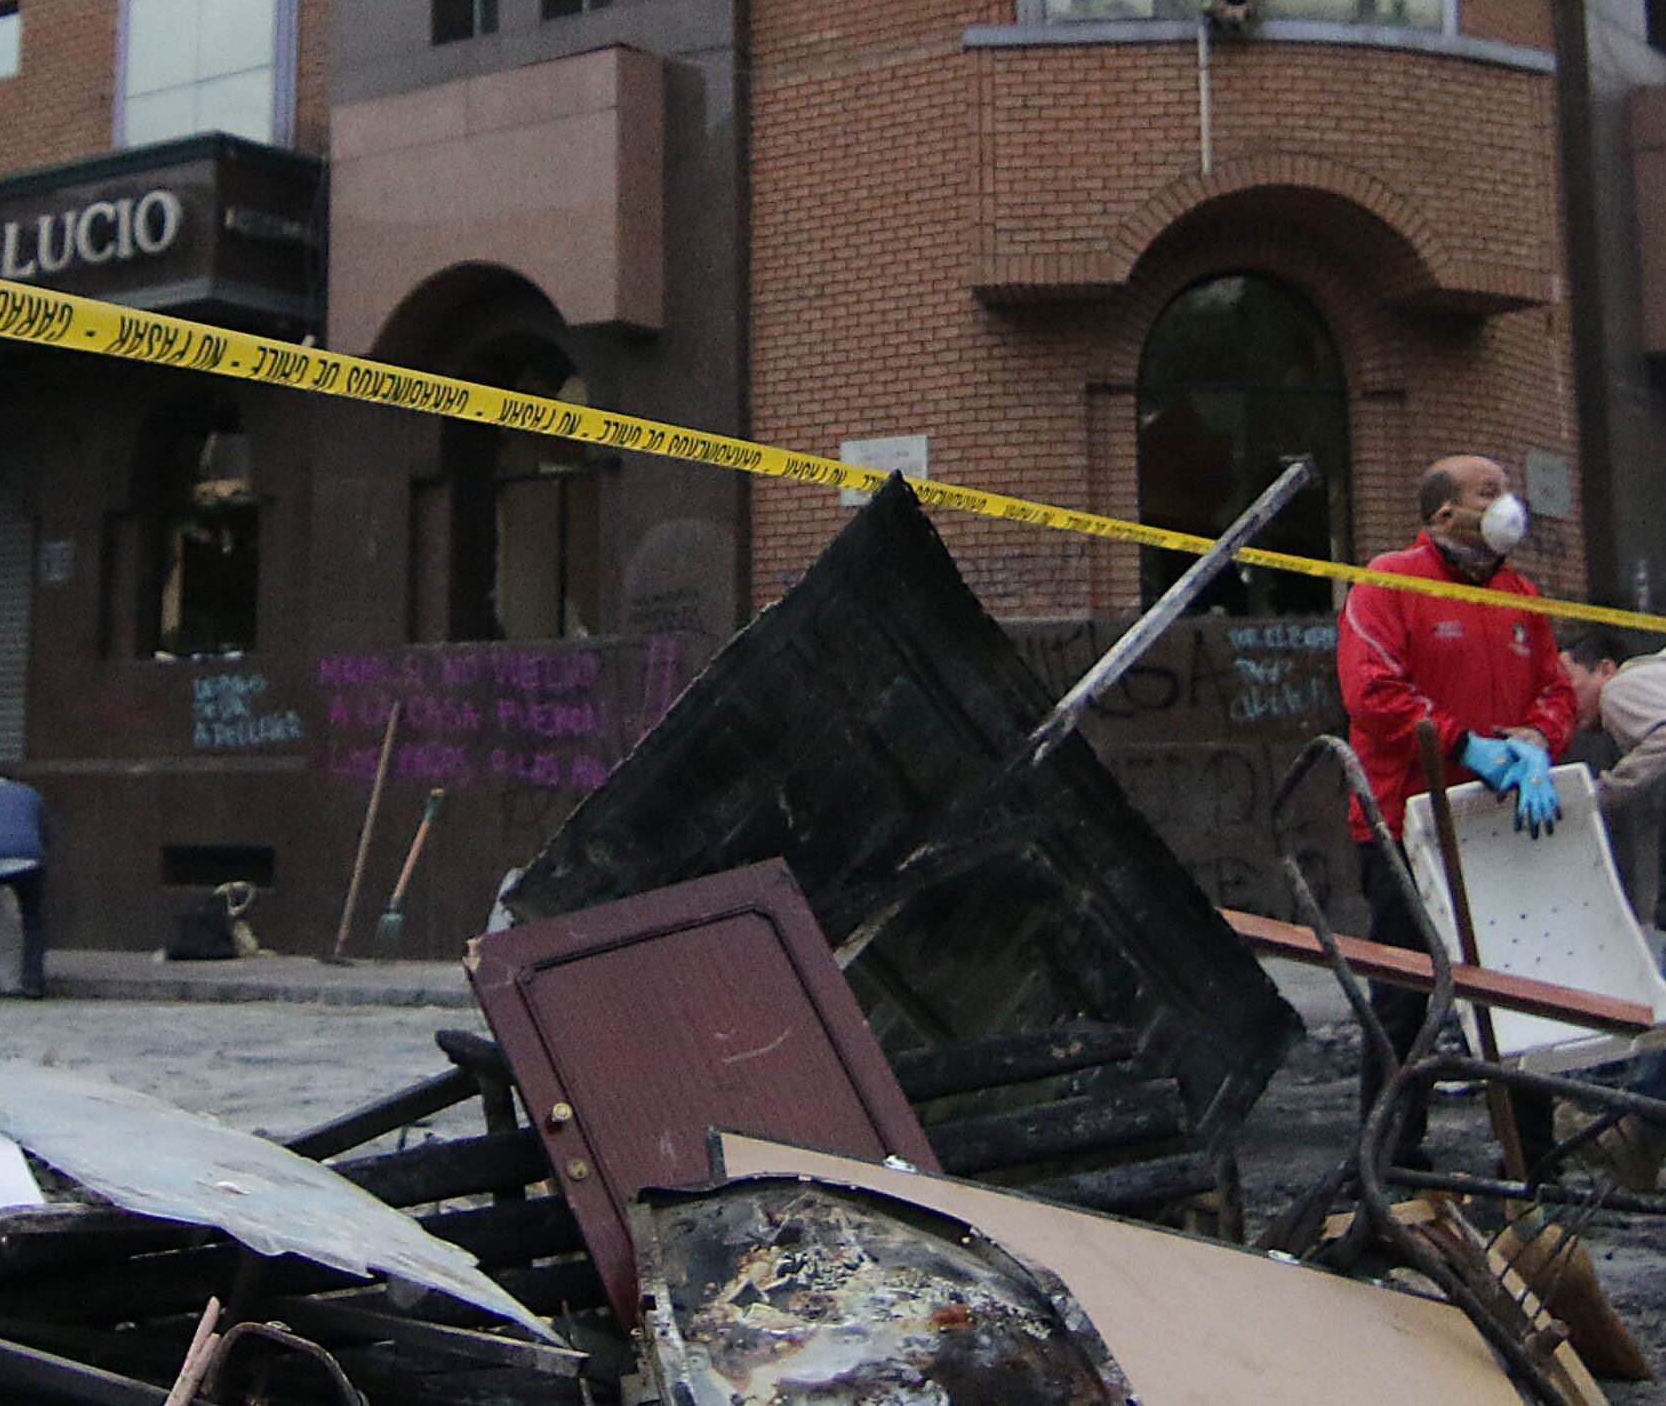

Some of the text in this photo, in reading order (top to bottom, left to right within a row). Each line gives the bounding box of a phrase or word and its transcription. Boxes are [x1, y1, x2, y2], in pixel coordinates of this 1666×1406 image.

[0, 189, 184, 279] LUCIO
[104, 315, 194, 360] PASAR
[189, 334, 227, 370] NO
[244, 345, 310, 383] CHILE
[308, 358, 341, 389] DE
[346, 365, 470, 416] CARABINEROS
